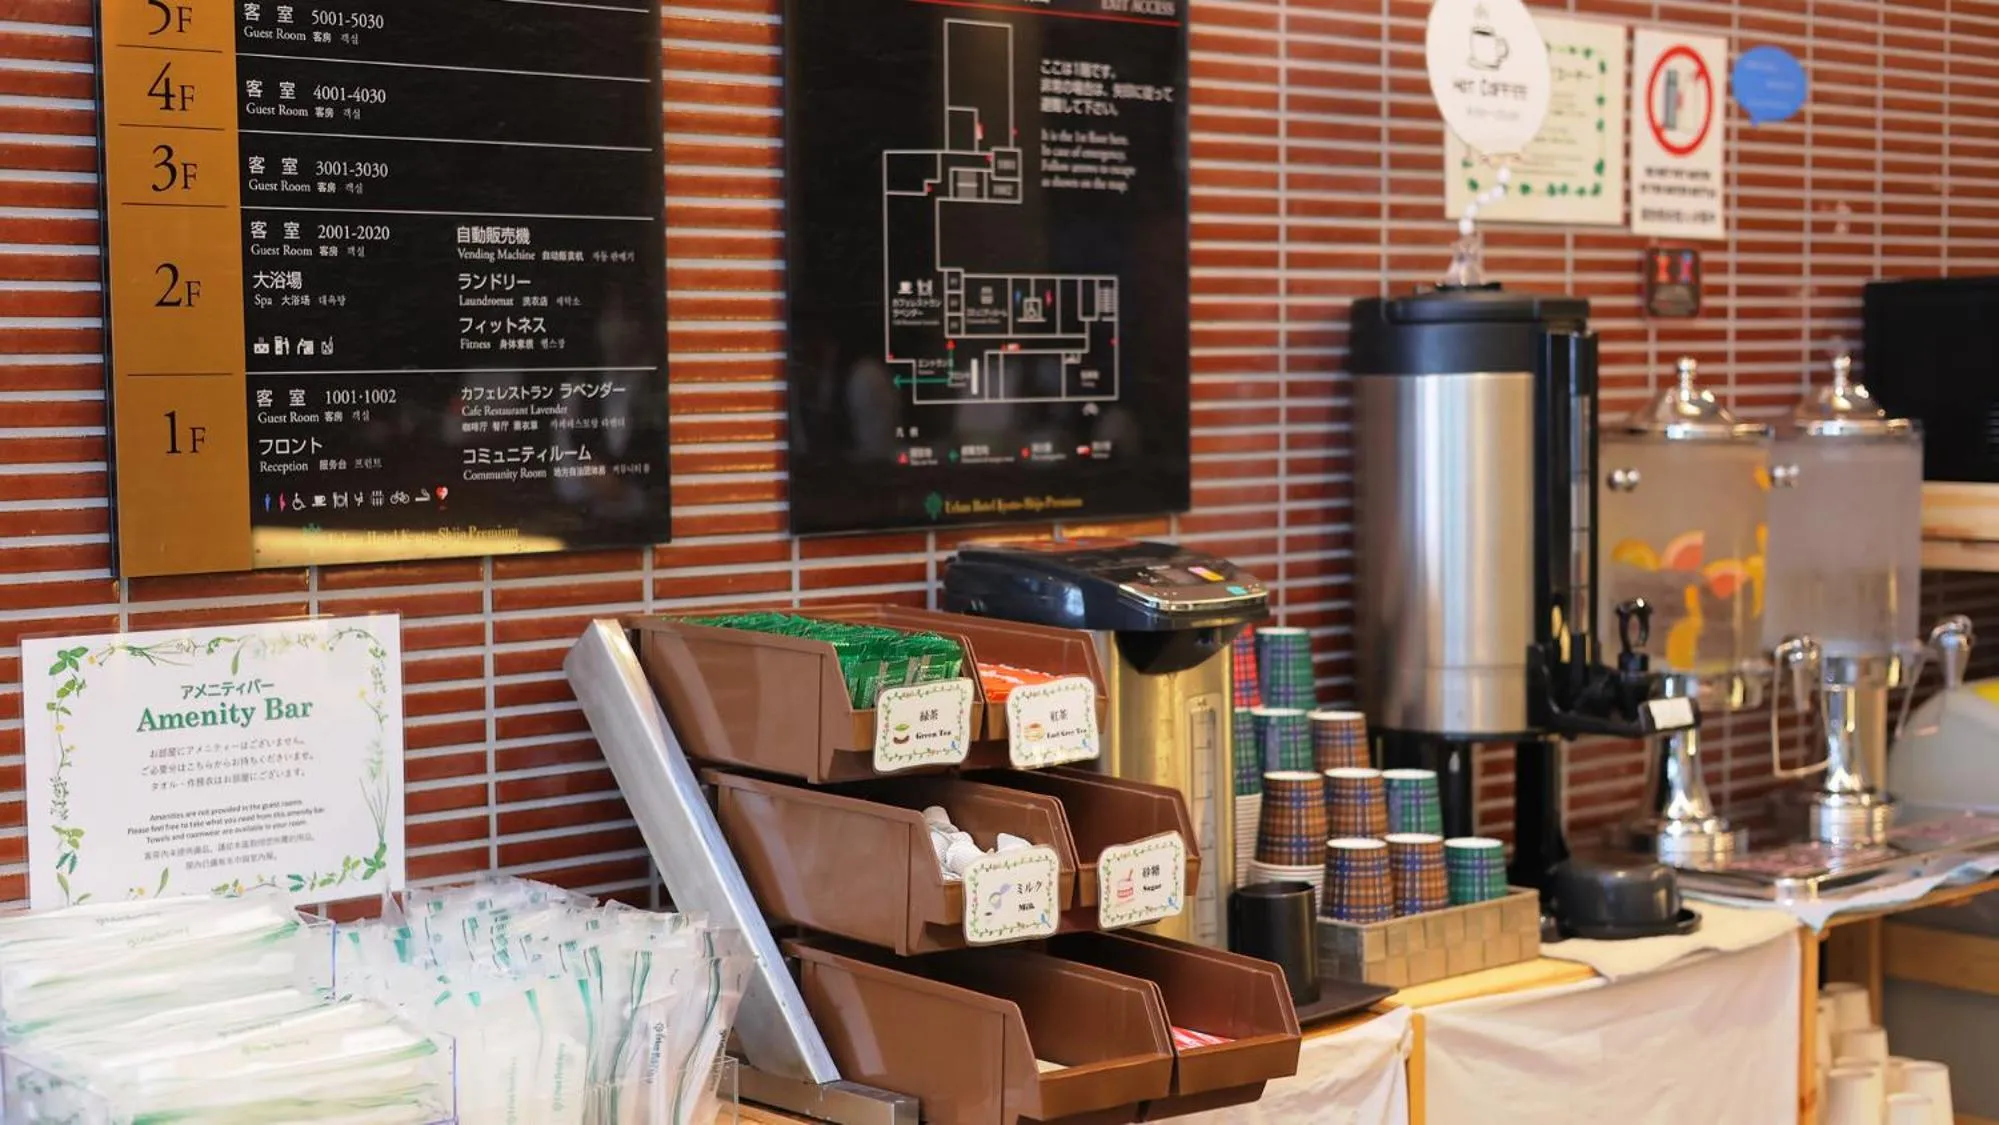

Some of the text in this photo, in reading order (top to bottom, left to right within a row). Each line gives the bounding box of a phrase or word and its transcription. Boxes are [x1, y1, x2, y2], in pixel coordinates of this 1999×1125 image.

[311, 10, 384, 29] 5001-5030
[243, 26, 273, 40] Guest
[276, 28, 306, 41] Room
[148, 62, 195, 111] 4F
[313, 85, 386, 104] 4001-4030
[246, 103, 275, 117] Guest
[278, 104, 308, 117] Room
[152, 144, 198, 192] 3F
[316, 161, 388, 179] 3001-3030
[248, 179, 278, 193] Guest
[280, 180, 310, 193] Room
[317, 224, 390, 241] 2001-2020
[456, 226, 531, 245] 自動販売機
[250, 244, 280, 257] Guest
[283, 245, 313, 257] Room
[457, 248, 495, 263] Vending
[497, 248, 535, 261] Machine
[253, 271, 302, 290] 大浴場
[458, 273, 531, 290] ランドリー
[254, 294, 272, 308] Spa
[459, 295, 514, 306] Laundromat
[459, 317, 546, 334] フィットネス
[460, 338, 491, 349] Fitness
[461, 381, 626, 401] カフェレストラン ラベンダー
[258, 412, 287, 424] Guest
[290, 411, 319, 423] Room
[461, 403, 568, 417] Cafe Restaurant Lavender
[164, 411, 206, 454] 1F
[258, 436, 323, 455] フロント
[463, 443, 592, 465] コミュニティルーム
[260, 460, 309, 475] Reception
[463, 468, 518, 482] Community
[520, 467, 547, 479] Room
[468, 525, 519, 538] Premium
[180, 678, 275, 700] アメニティバー
[136, 696, 314, 733] Amenity Bar
[920, 708, 939, 721] 緑茶
[1050, 708, 1068, 721] 紅茶
[915, 729, 951, 741] Green Tea
[1016, 880, 1043, 895] ミルク
[1143, 883, 1162, 893] Sugar
[1018, 903, 1035, 912] Milk
